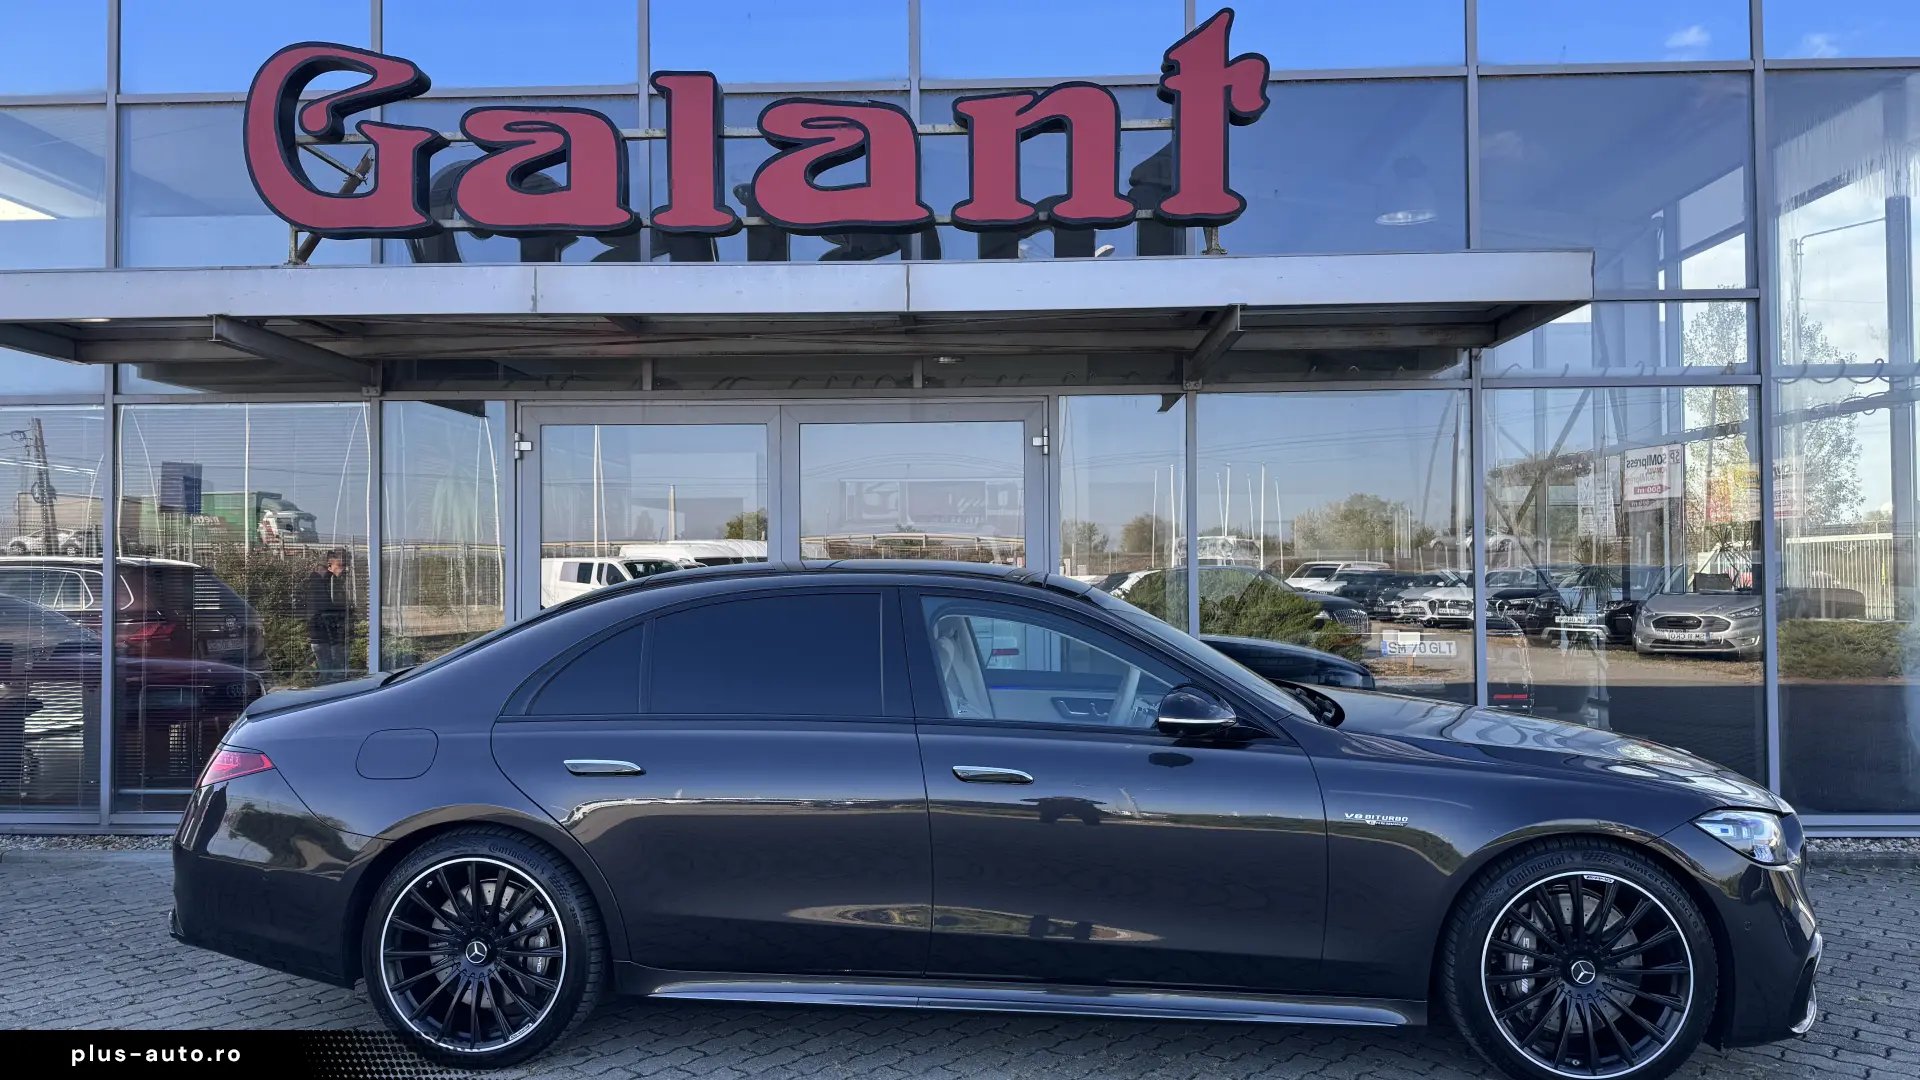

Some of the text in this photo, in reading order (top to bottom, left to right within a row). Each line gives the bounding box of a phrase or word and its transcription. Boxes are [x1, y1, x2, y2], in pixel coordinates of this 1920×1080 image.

[245, 8, 1270, 239] Galant
[1429, 642, 1454, 654] GLT
[1365, 814, 1409, 822] BITURBO
[488, 842, 540, 871] Continental
[1507, 853, 1568, 889] Continental
